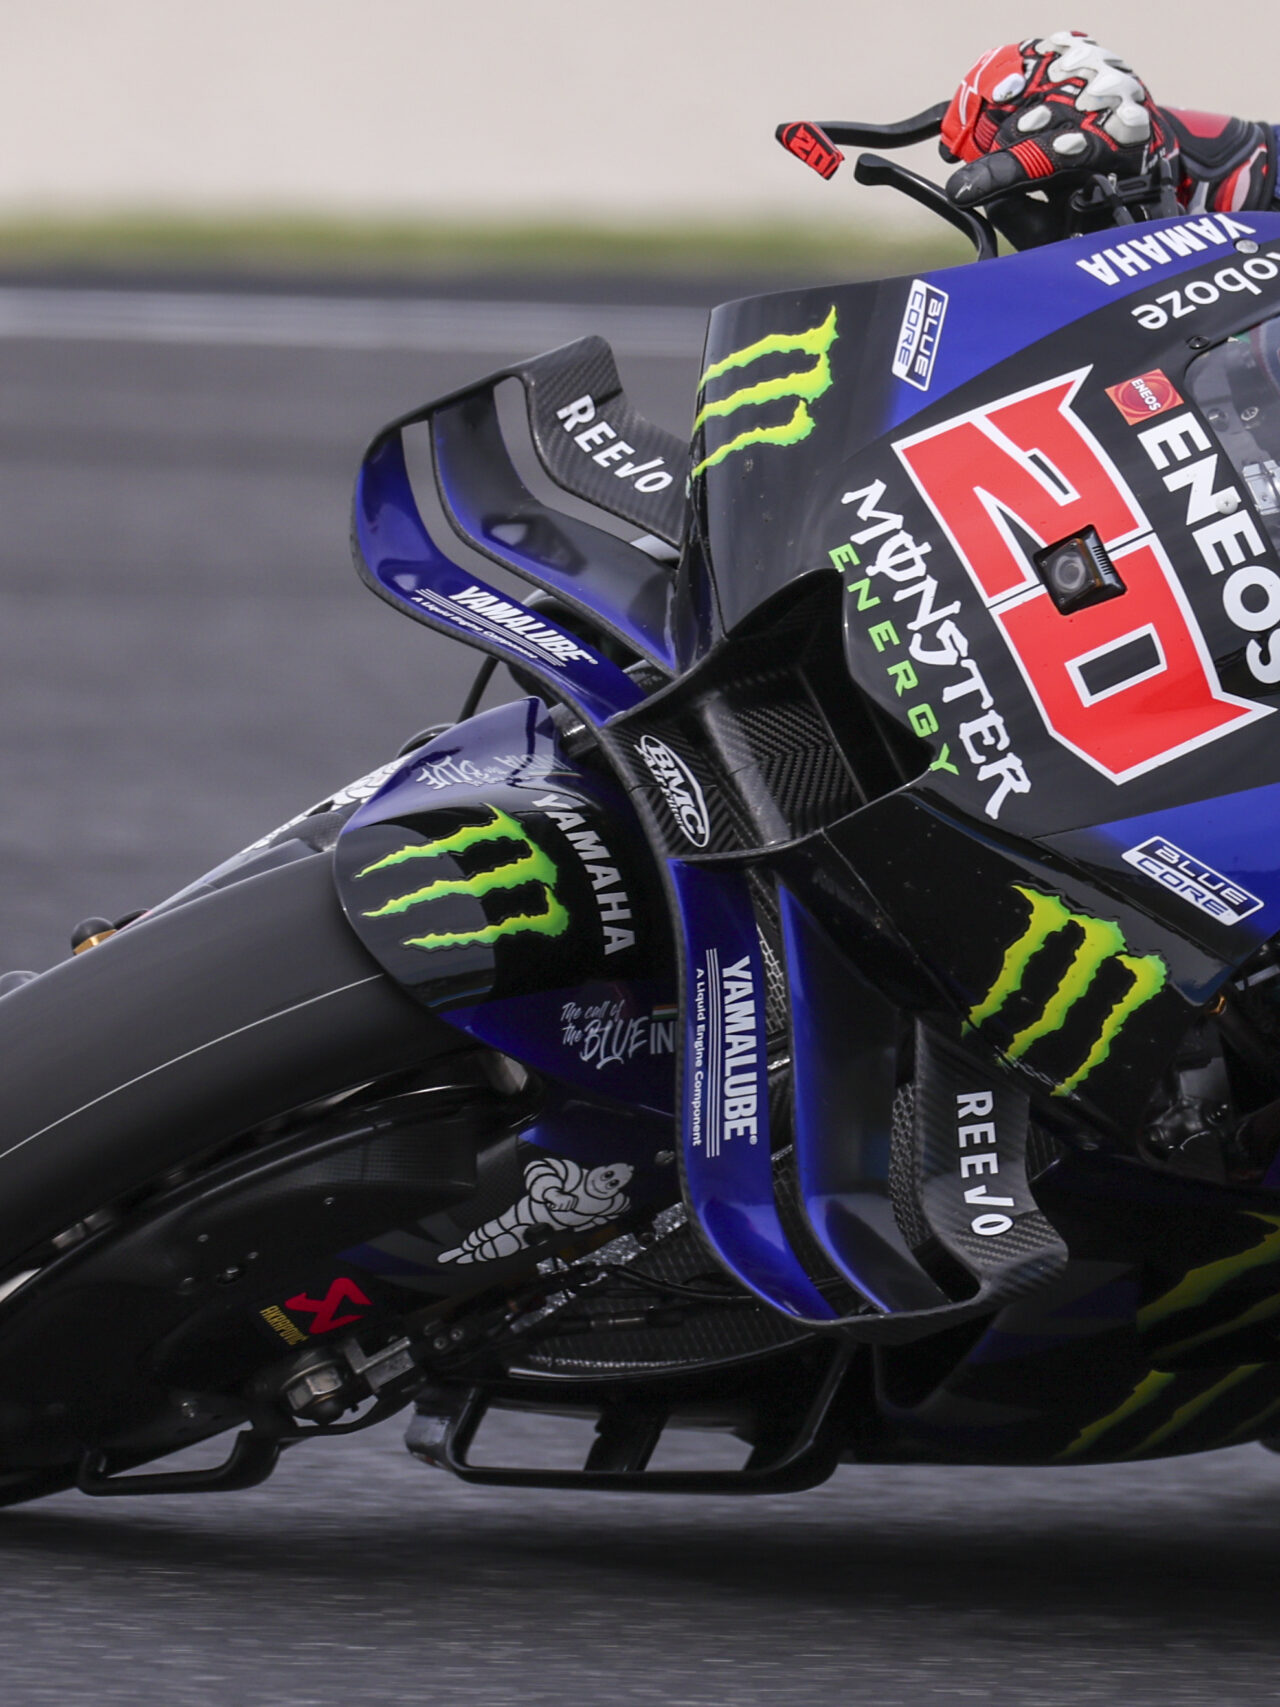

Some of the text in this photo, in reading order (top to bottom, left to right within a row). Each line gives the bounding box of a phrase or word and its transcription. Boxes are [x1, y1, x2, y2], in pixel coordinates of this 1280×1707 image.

[1075, 213, 1256, 286] YAMAHA
[897, 290, 925, 367] CORE
[913, 298, 943, 377] BLUE
[1130, 377, 1163, 413] ENEOS
[556, 395, 673, 493] REEVO
[890, 363, 1278, 785] 20
[828, 543, 960, 776] ENERGY
[841, 478, 1031, 820] MONSTER
[645, 744, 706, 835] BMC
[533, 794, 635, 956] YAMAHA
[1136, 857, 1229, 916] CORE
[1154, 845, 1248, 906] BLUE
[560, 1001, 582, 1022] The
[584, 1000, 610, 1020] call
[562, 1021, 582, 1046] the
[579, 1016, 649, 1070] BLUE
[722, 955, 758, 1141] YAMALUBE
[692, 968, 706, 1147] A Liquid Engine Component
[956, 1090, 1014, 1236] REEVO
